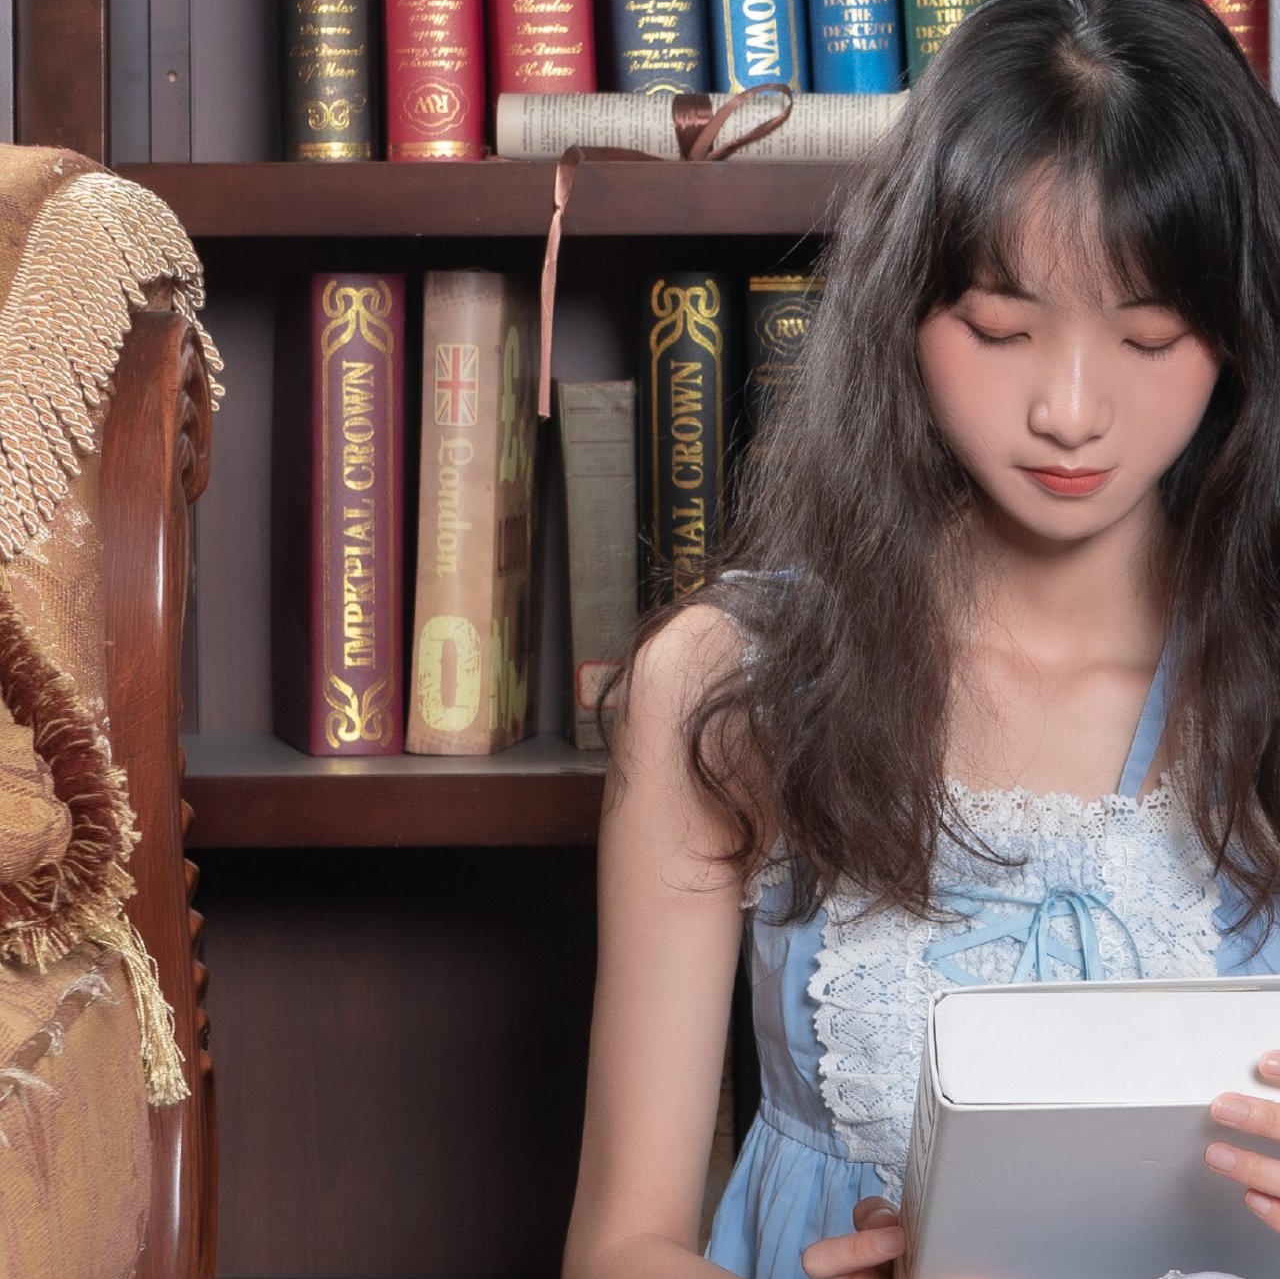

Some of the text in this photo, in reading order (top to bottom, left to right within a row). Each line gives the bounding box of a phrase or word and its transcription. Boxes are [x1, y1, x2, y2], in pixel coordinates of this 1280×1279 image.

[842, 7, 874, 22] THE
[823, 22, 895, 38] DESCENT
[827, 38, 849, 54] OF
[414, 93, 449, 114] RW
[342, 360, 376, 491] CROWN
[670, 360, 705, 491] CROWN
[435, 434, 475, 580] London
